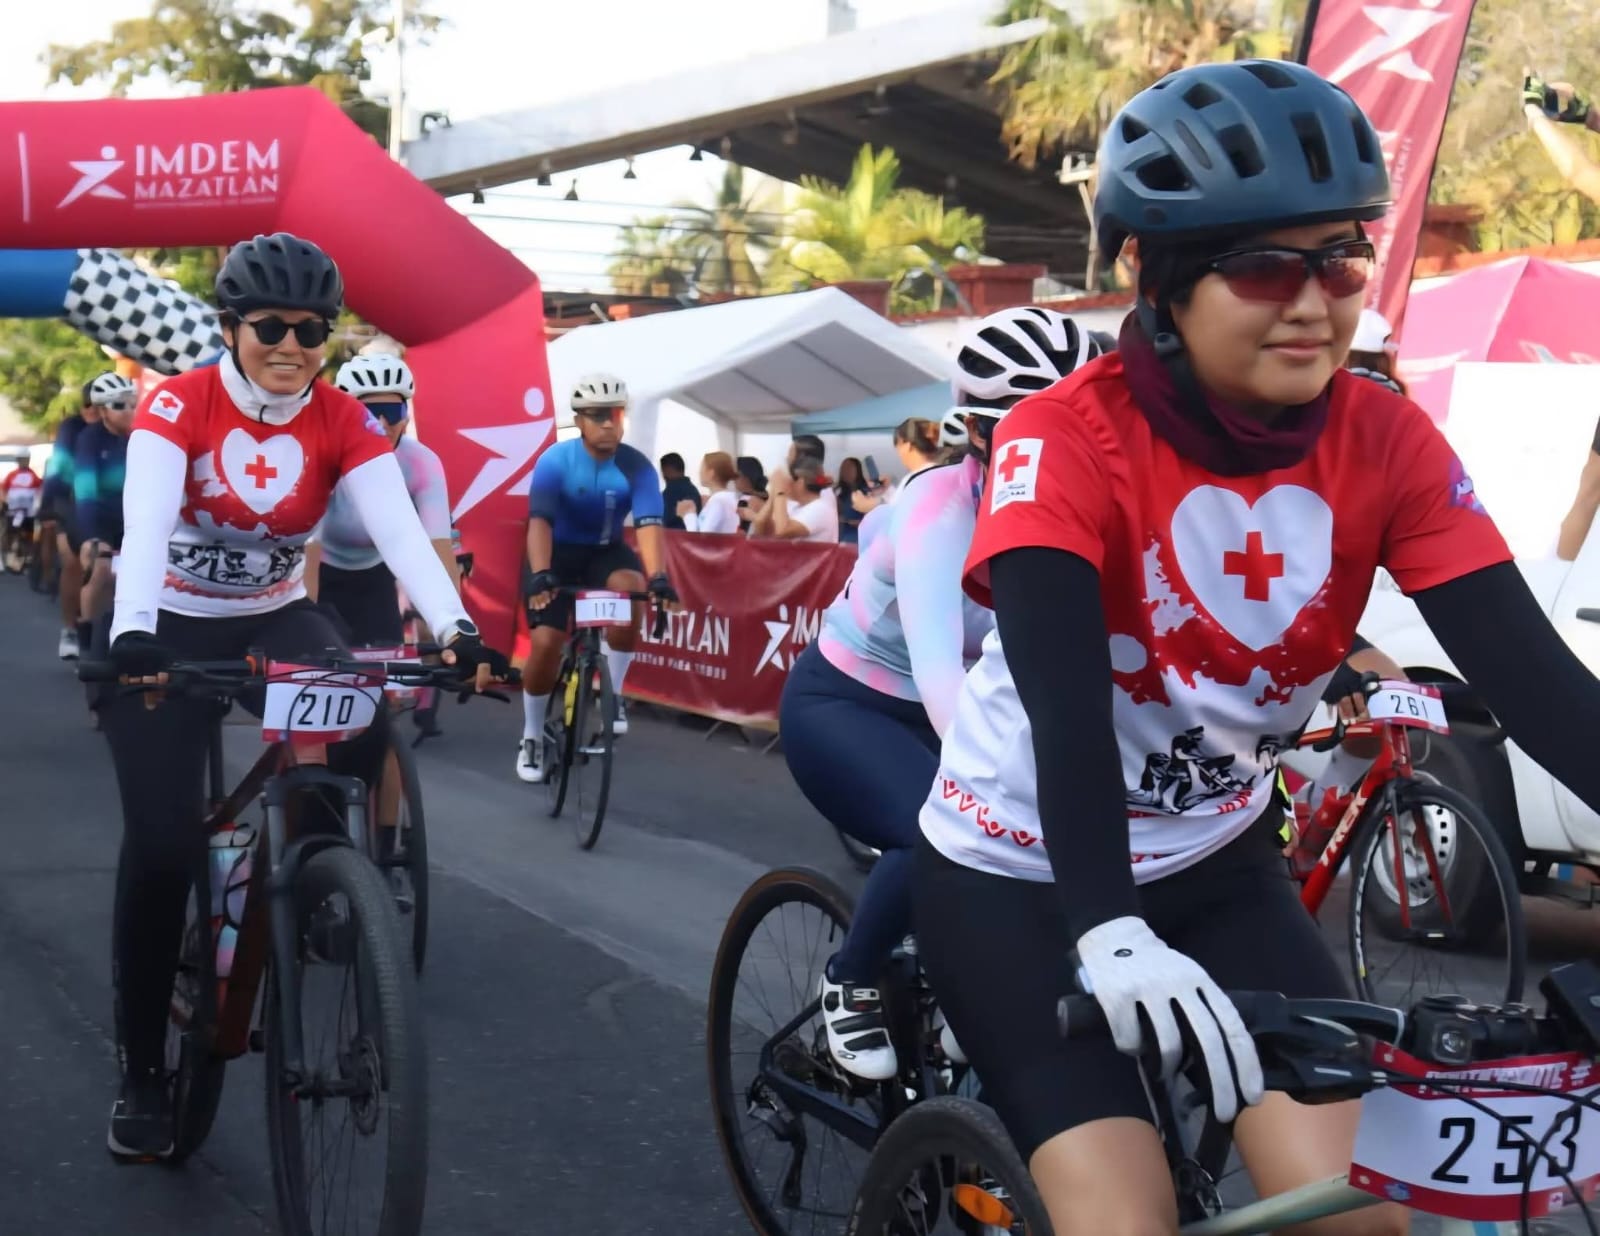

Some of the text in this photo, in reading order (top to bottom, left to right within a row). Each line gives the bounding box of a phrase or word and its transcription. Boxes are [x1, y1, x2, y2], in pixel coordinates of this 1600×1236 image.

[135, 139, 279, 176] IMDEM
[297, 694, 355, 726] 210
[1390, 694, 1428, 719] 261
[1431, 1103, 1582, 1184] 253
